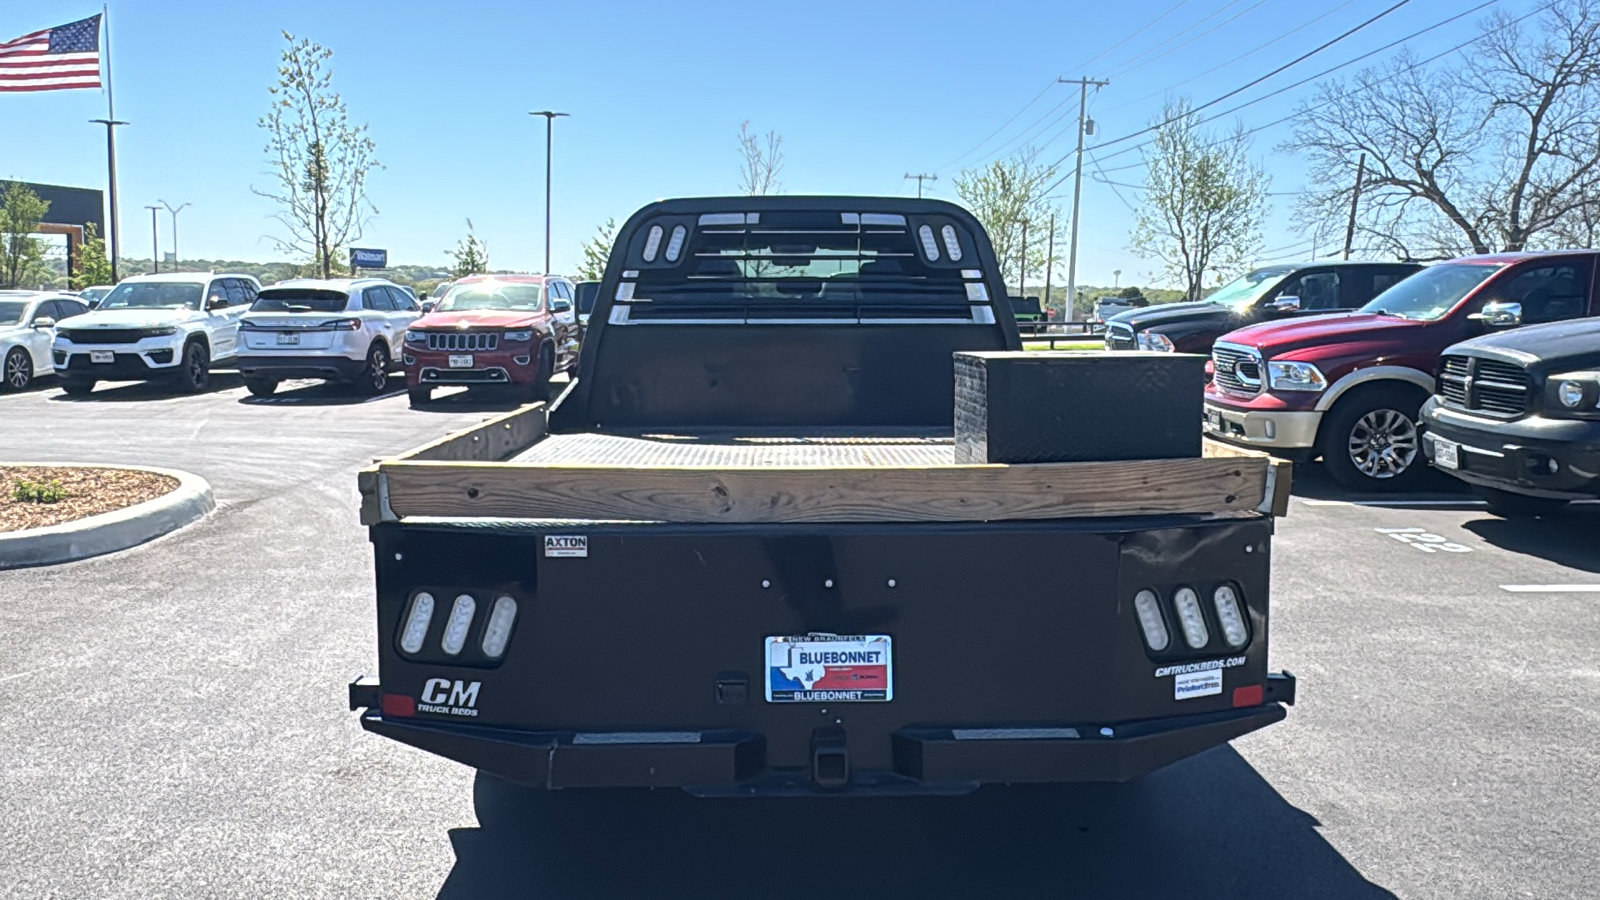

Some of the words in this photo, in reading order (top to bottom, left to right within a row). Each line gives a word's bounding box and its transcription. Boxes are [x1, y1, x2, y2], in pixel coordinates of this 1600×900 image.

[355, 250, 385, 262] Walmart
[546, 537, 586, 547] AXTON
[1374, 527, 1473, 553] 122
[799, 651, 881, 664] BLUEBONNET
[1155, 656, 1247, 678] CMTRUCKBEDS.COM
[421, 678, 482, 708] CM
[793, 691, 863, 701] BLUEBONNET
[417, 703, 450, 714] TRUCK
[450, 707, 479, 717] BEDS
